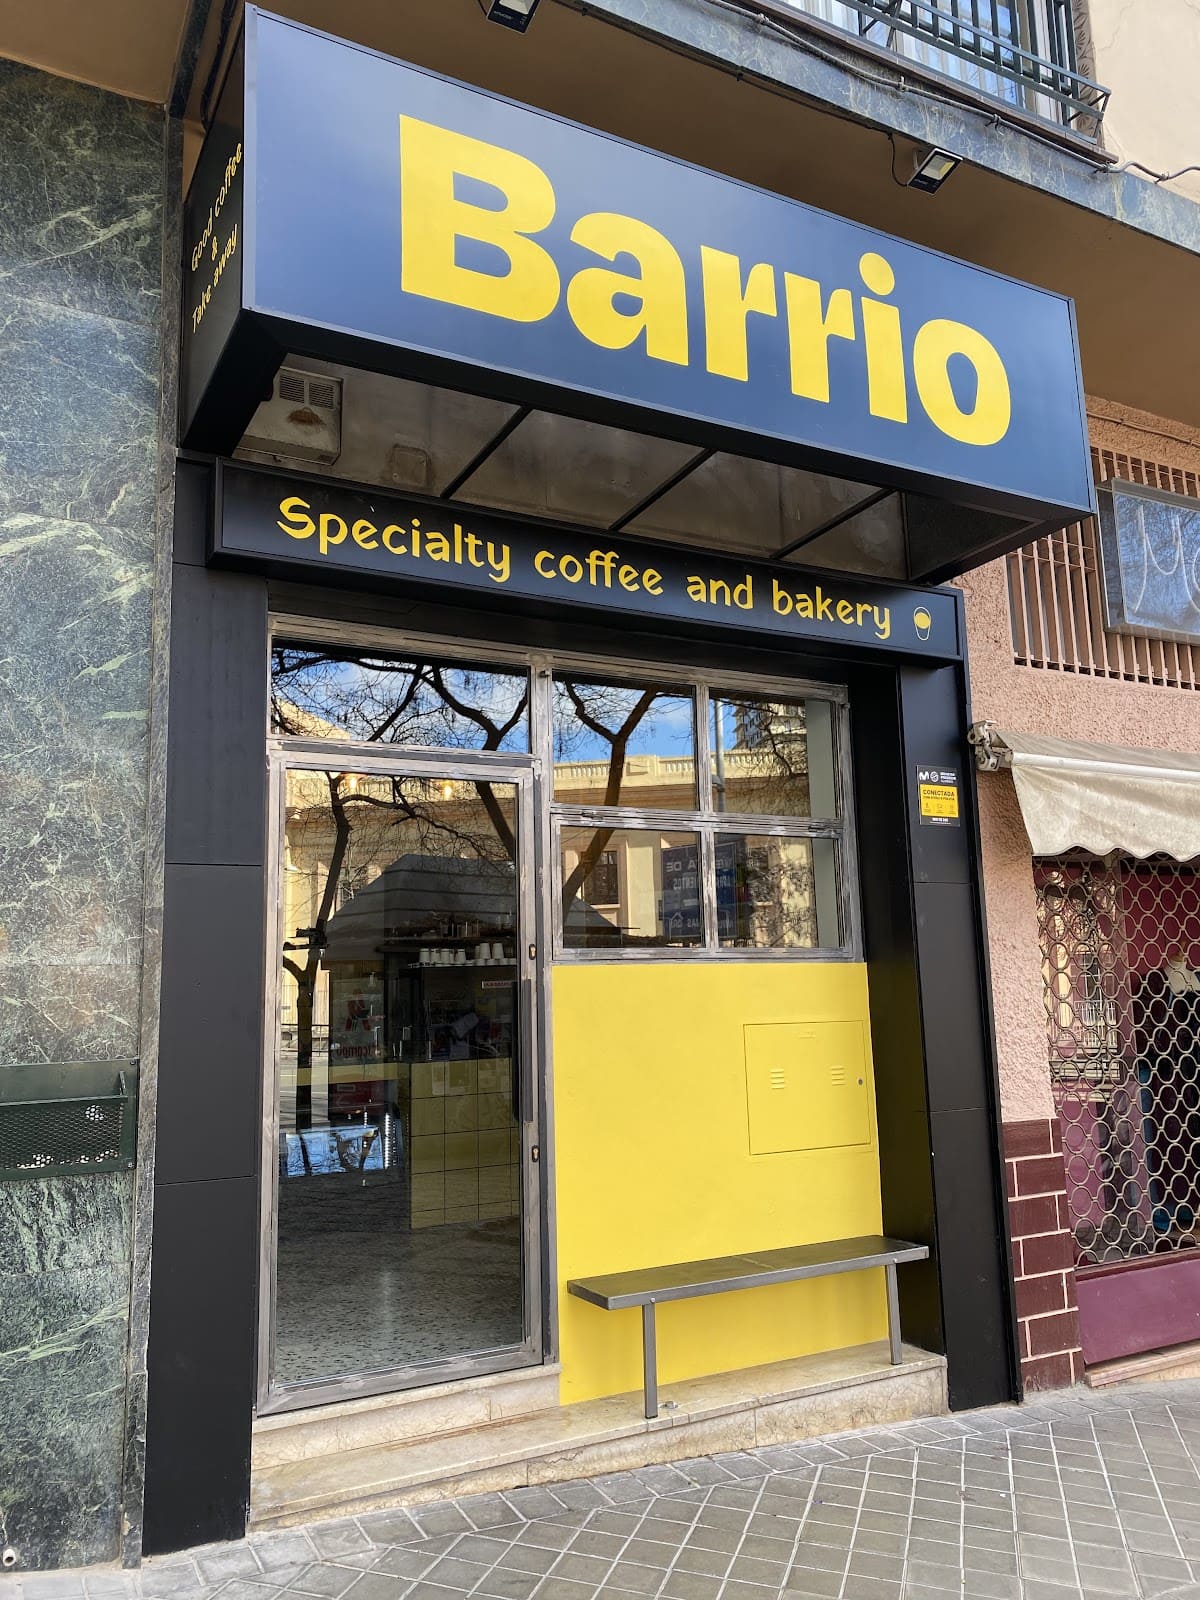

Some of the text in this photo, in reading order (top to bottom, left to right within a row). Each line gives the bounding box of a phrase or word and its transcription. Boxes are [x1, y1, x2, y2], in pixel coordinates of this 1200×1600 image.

[191, 142, 242, 272] Good coffee
[211, 236, 218, 261] &
[192, 223, 237, 334] Take away
[399, 114, 1011, 446] Barrio
[276, 496, 891, 641] Specialty coffee and bakery
